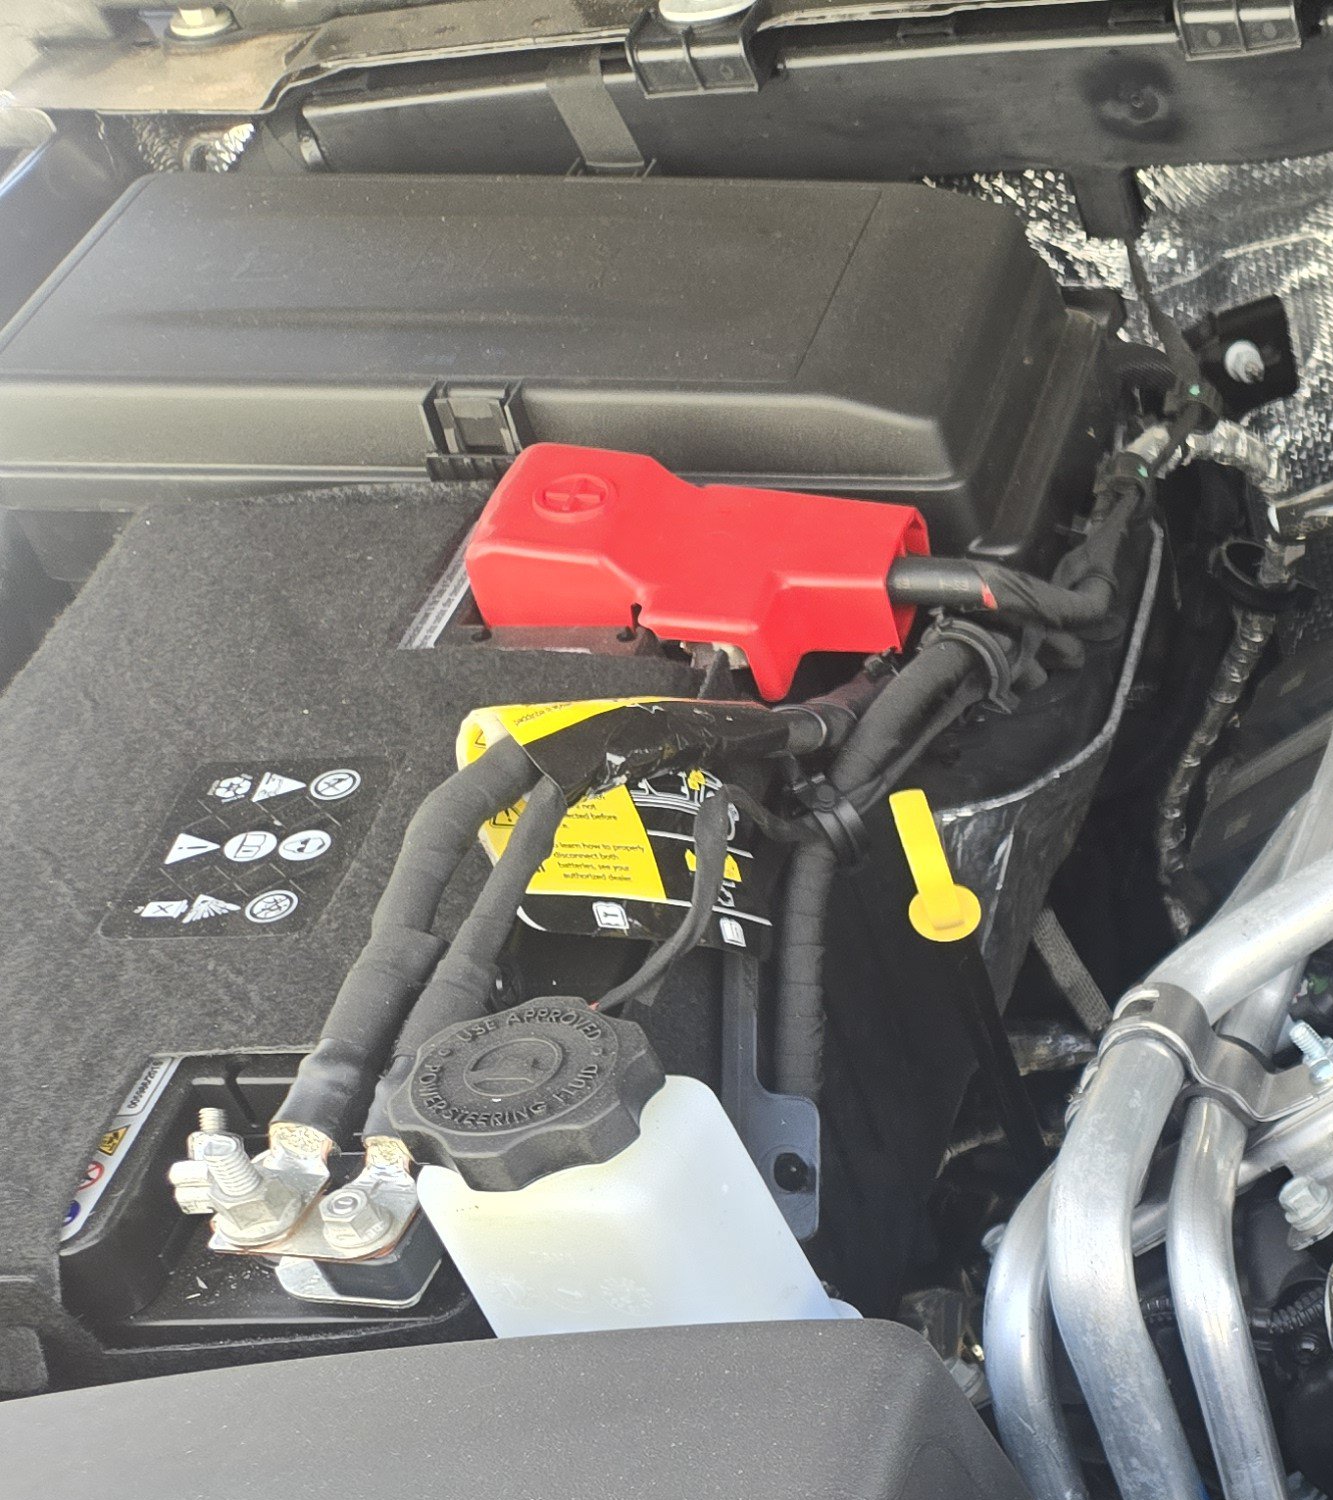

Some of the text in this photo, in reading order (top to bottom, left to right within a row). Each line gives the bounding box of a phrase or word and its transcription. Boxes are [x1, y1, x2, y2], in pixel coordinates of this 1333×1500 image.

[456, 1006, 602, 1044] USE APPROVED
[419, 1062, 600, 1127] POWER STEERING FLUID
